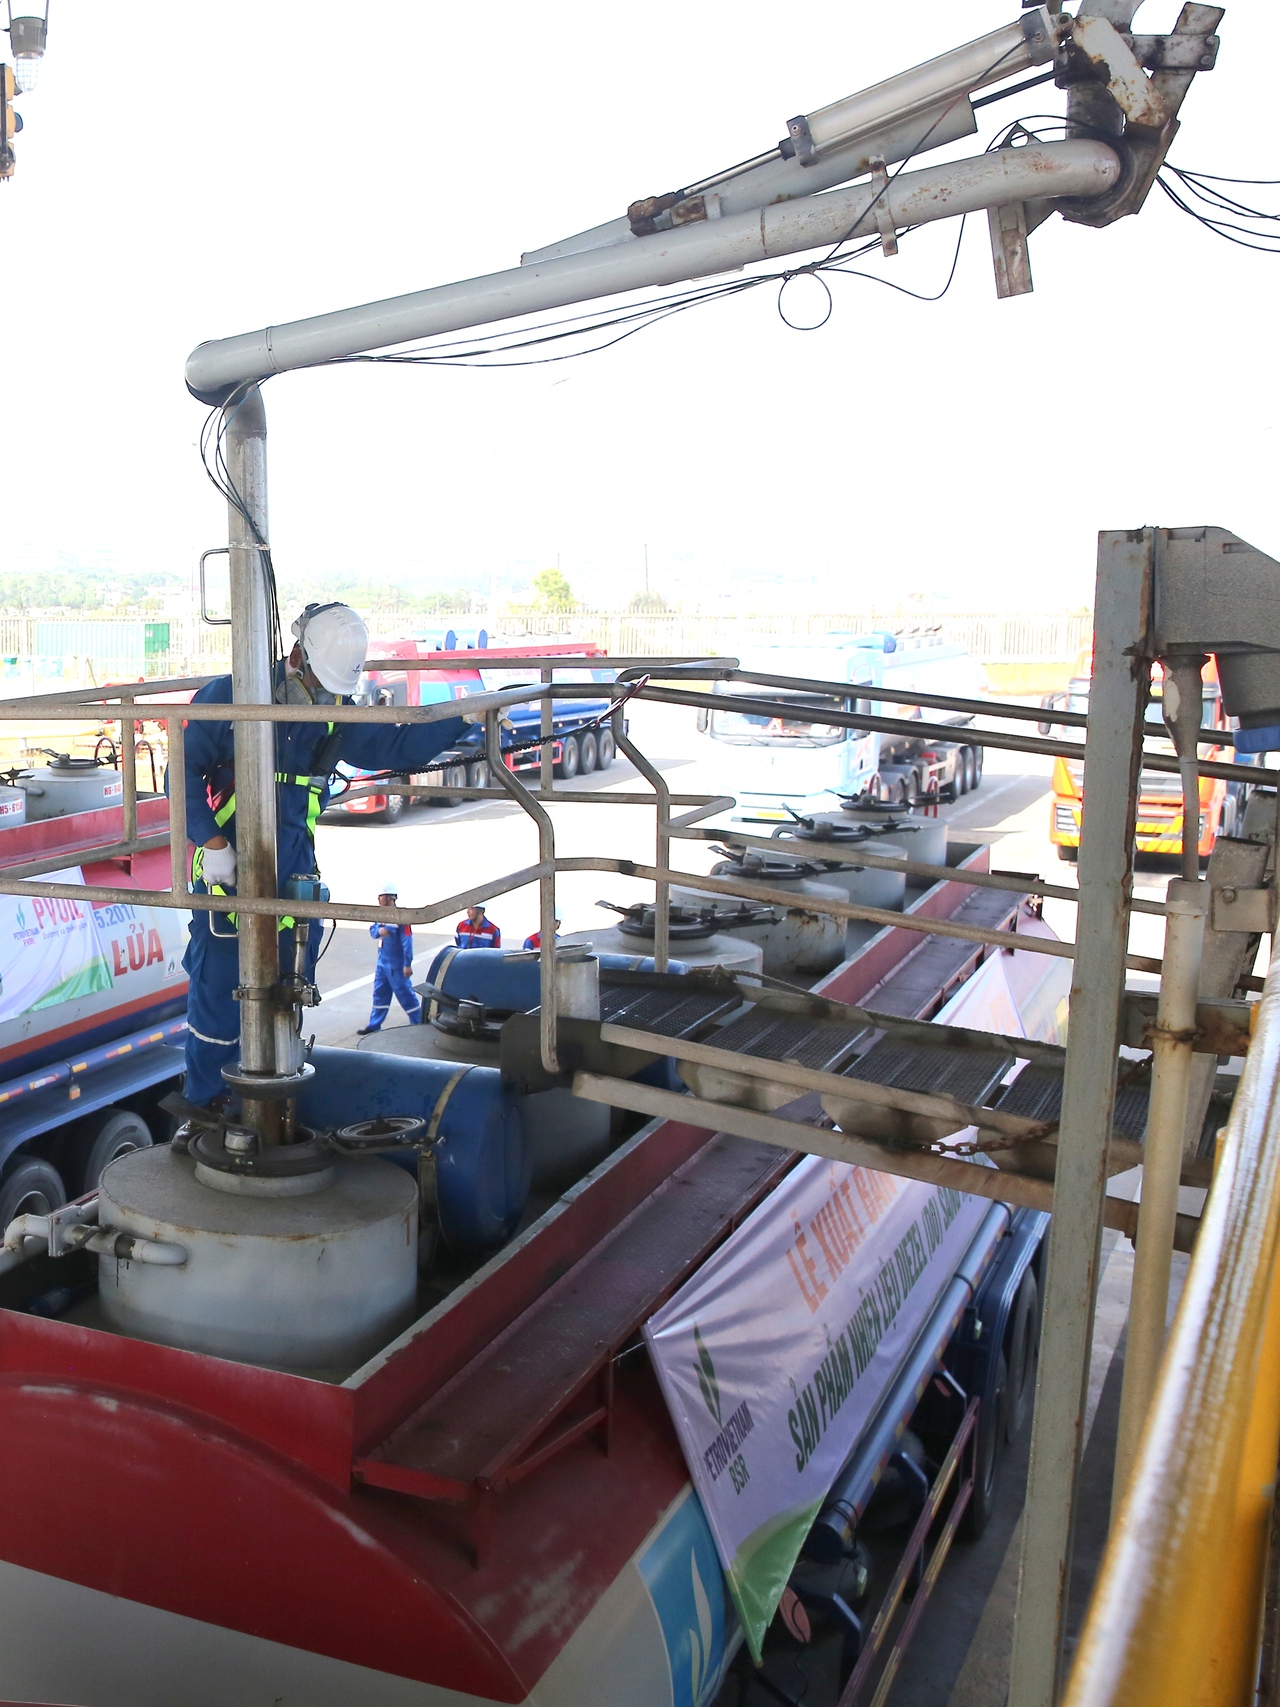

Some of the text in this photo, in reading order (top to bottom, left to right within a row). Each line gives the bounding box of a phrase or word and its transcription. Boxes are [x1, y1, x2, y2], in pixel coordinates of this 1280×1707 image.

[111, 922, 164, 977] LỬA
[786, 1208, 829, 1314] LỄ
[810, 1165, 865, 1281] XUẤT
[787, 1377, 820, 1473] SẢN
[813, 1323, 854, 1432] PHẨM
[846, 1287, 883, 1380] NHIÊN
[894, 1219, 928, 1301] DIEZEL
[728, 1453, 750, 1495] BSR
